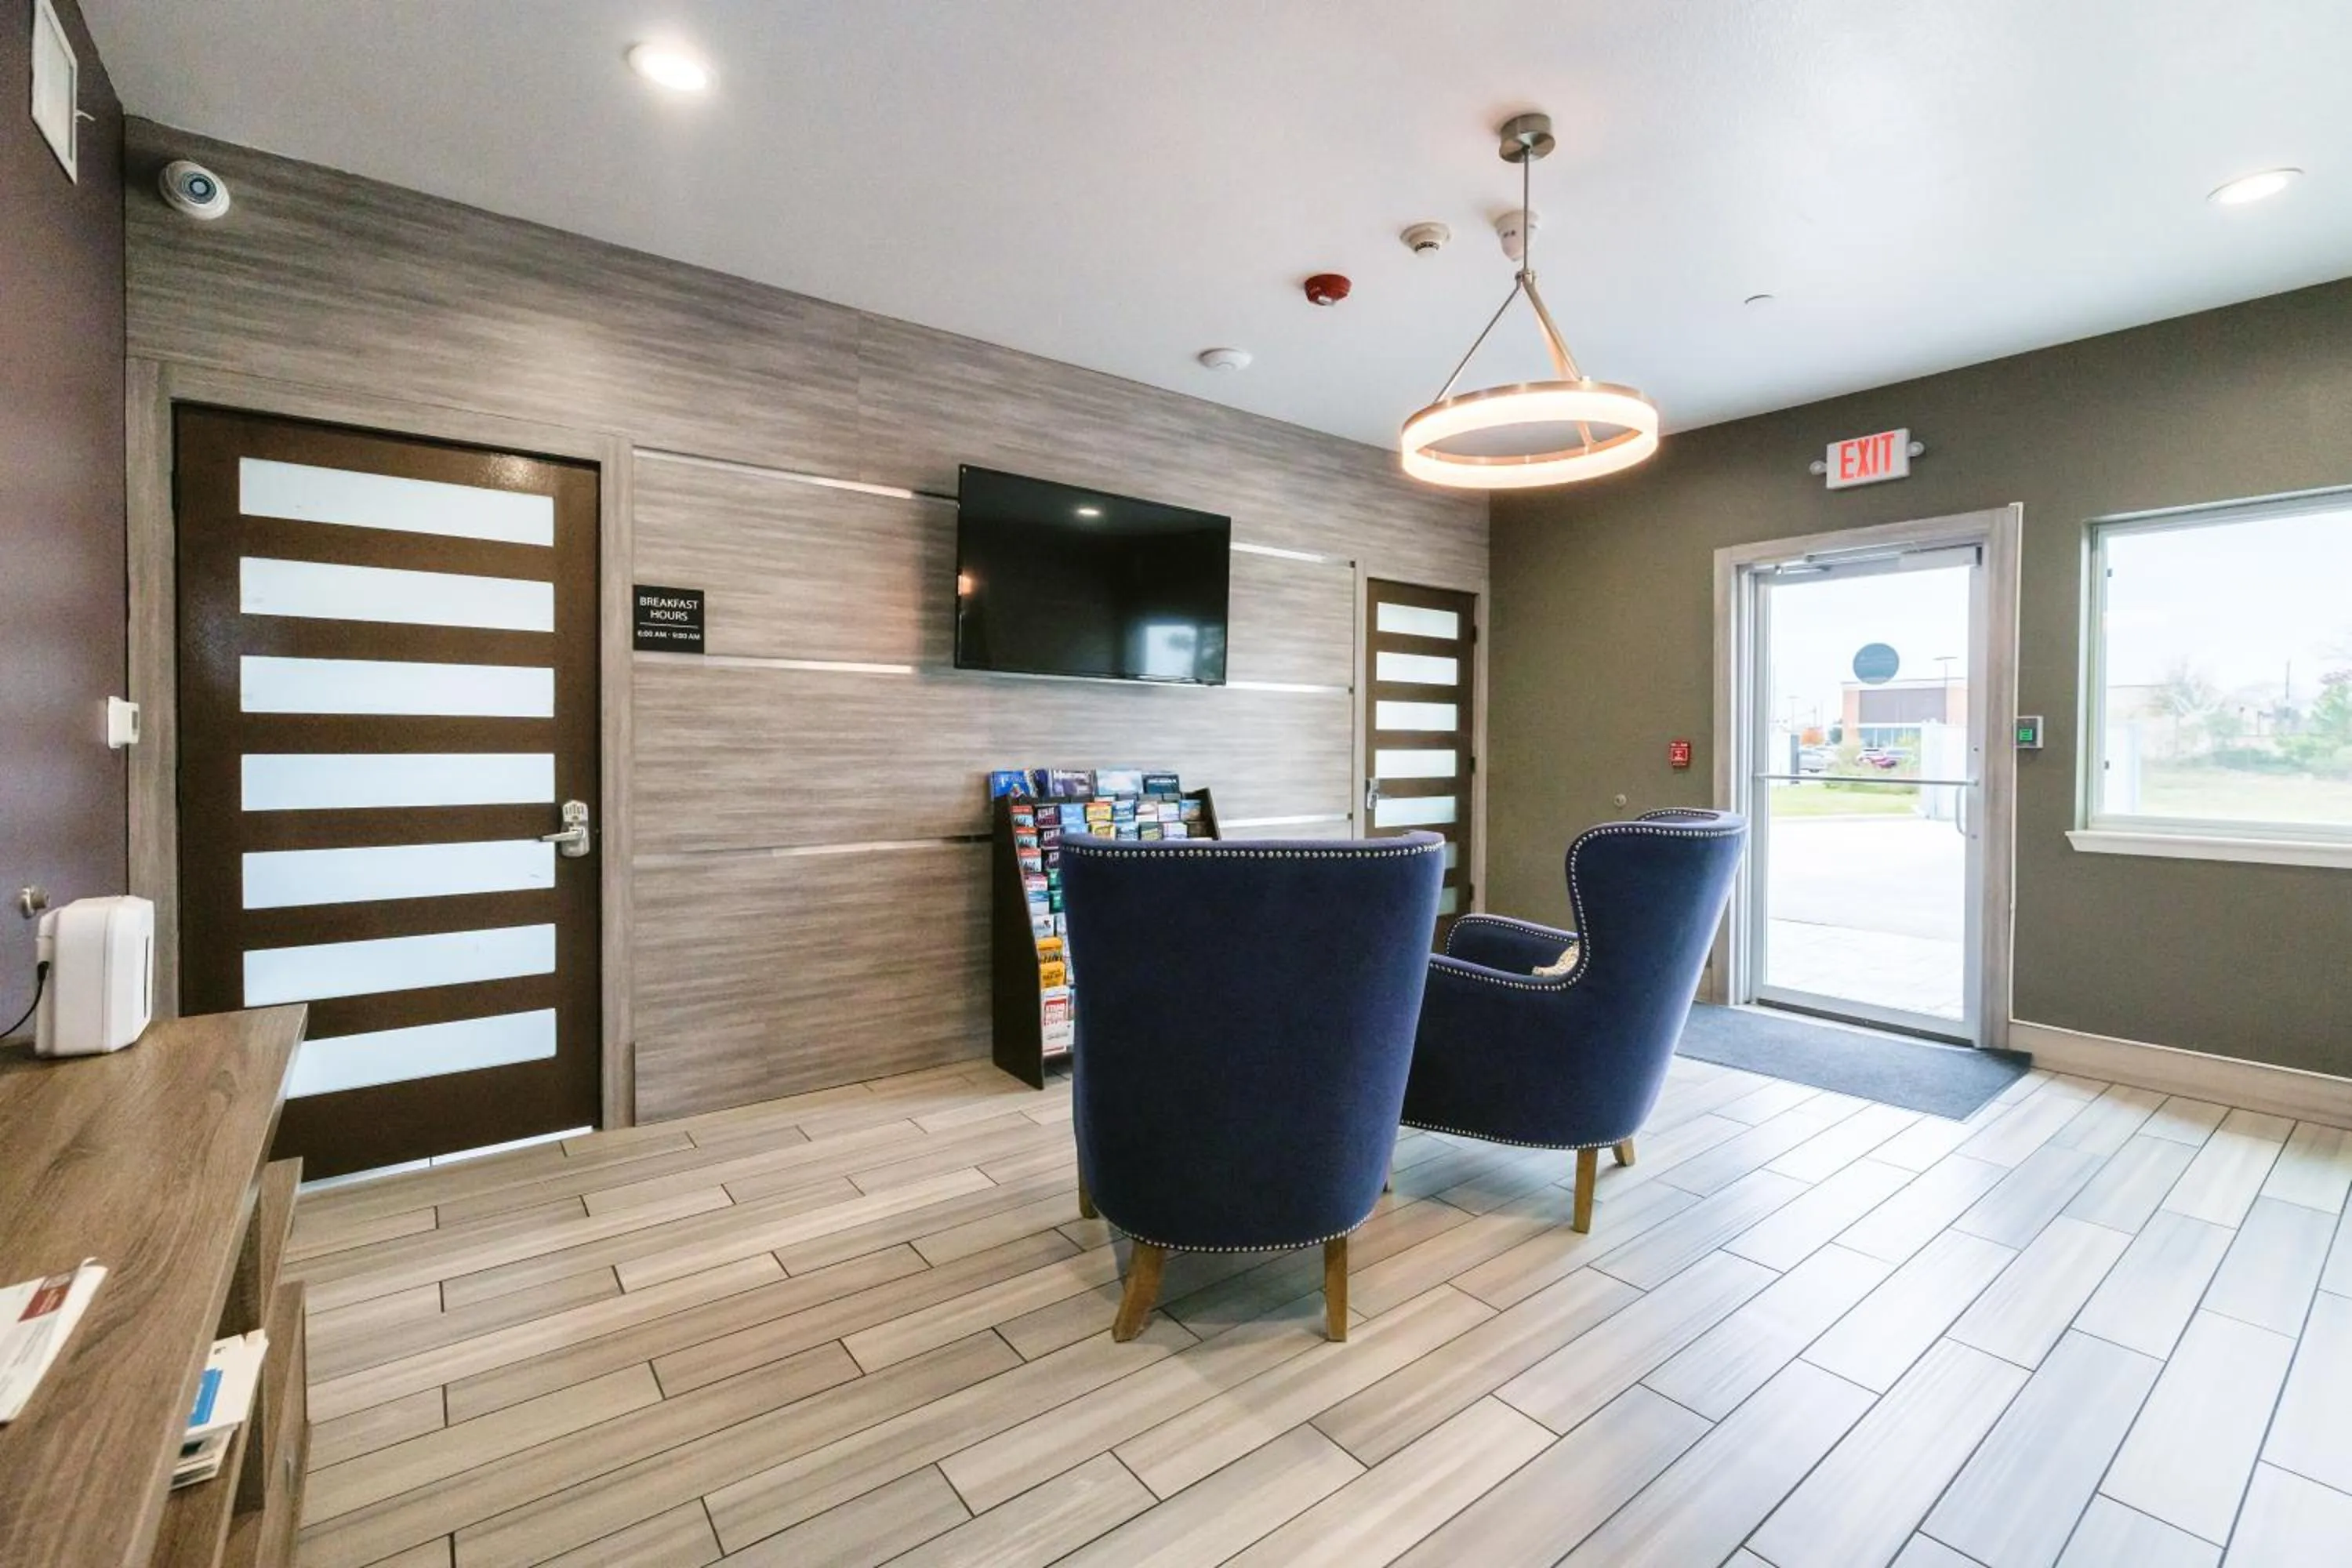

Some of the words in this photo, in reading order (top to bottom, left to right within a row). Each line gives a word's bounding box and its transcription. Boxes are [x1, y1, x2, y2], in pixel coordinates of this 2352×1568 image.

[1839, 433, 1895, 480] EXIT
[639, 596, 699, 609] BREAKFAST
[650, 610, 688, 621] HOURS
